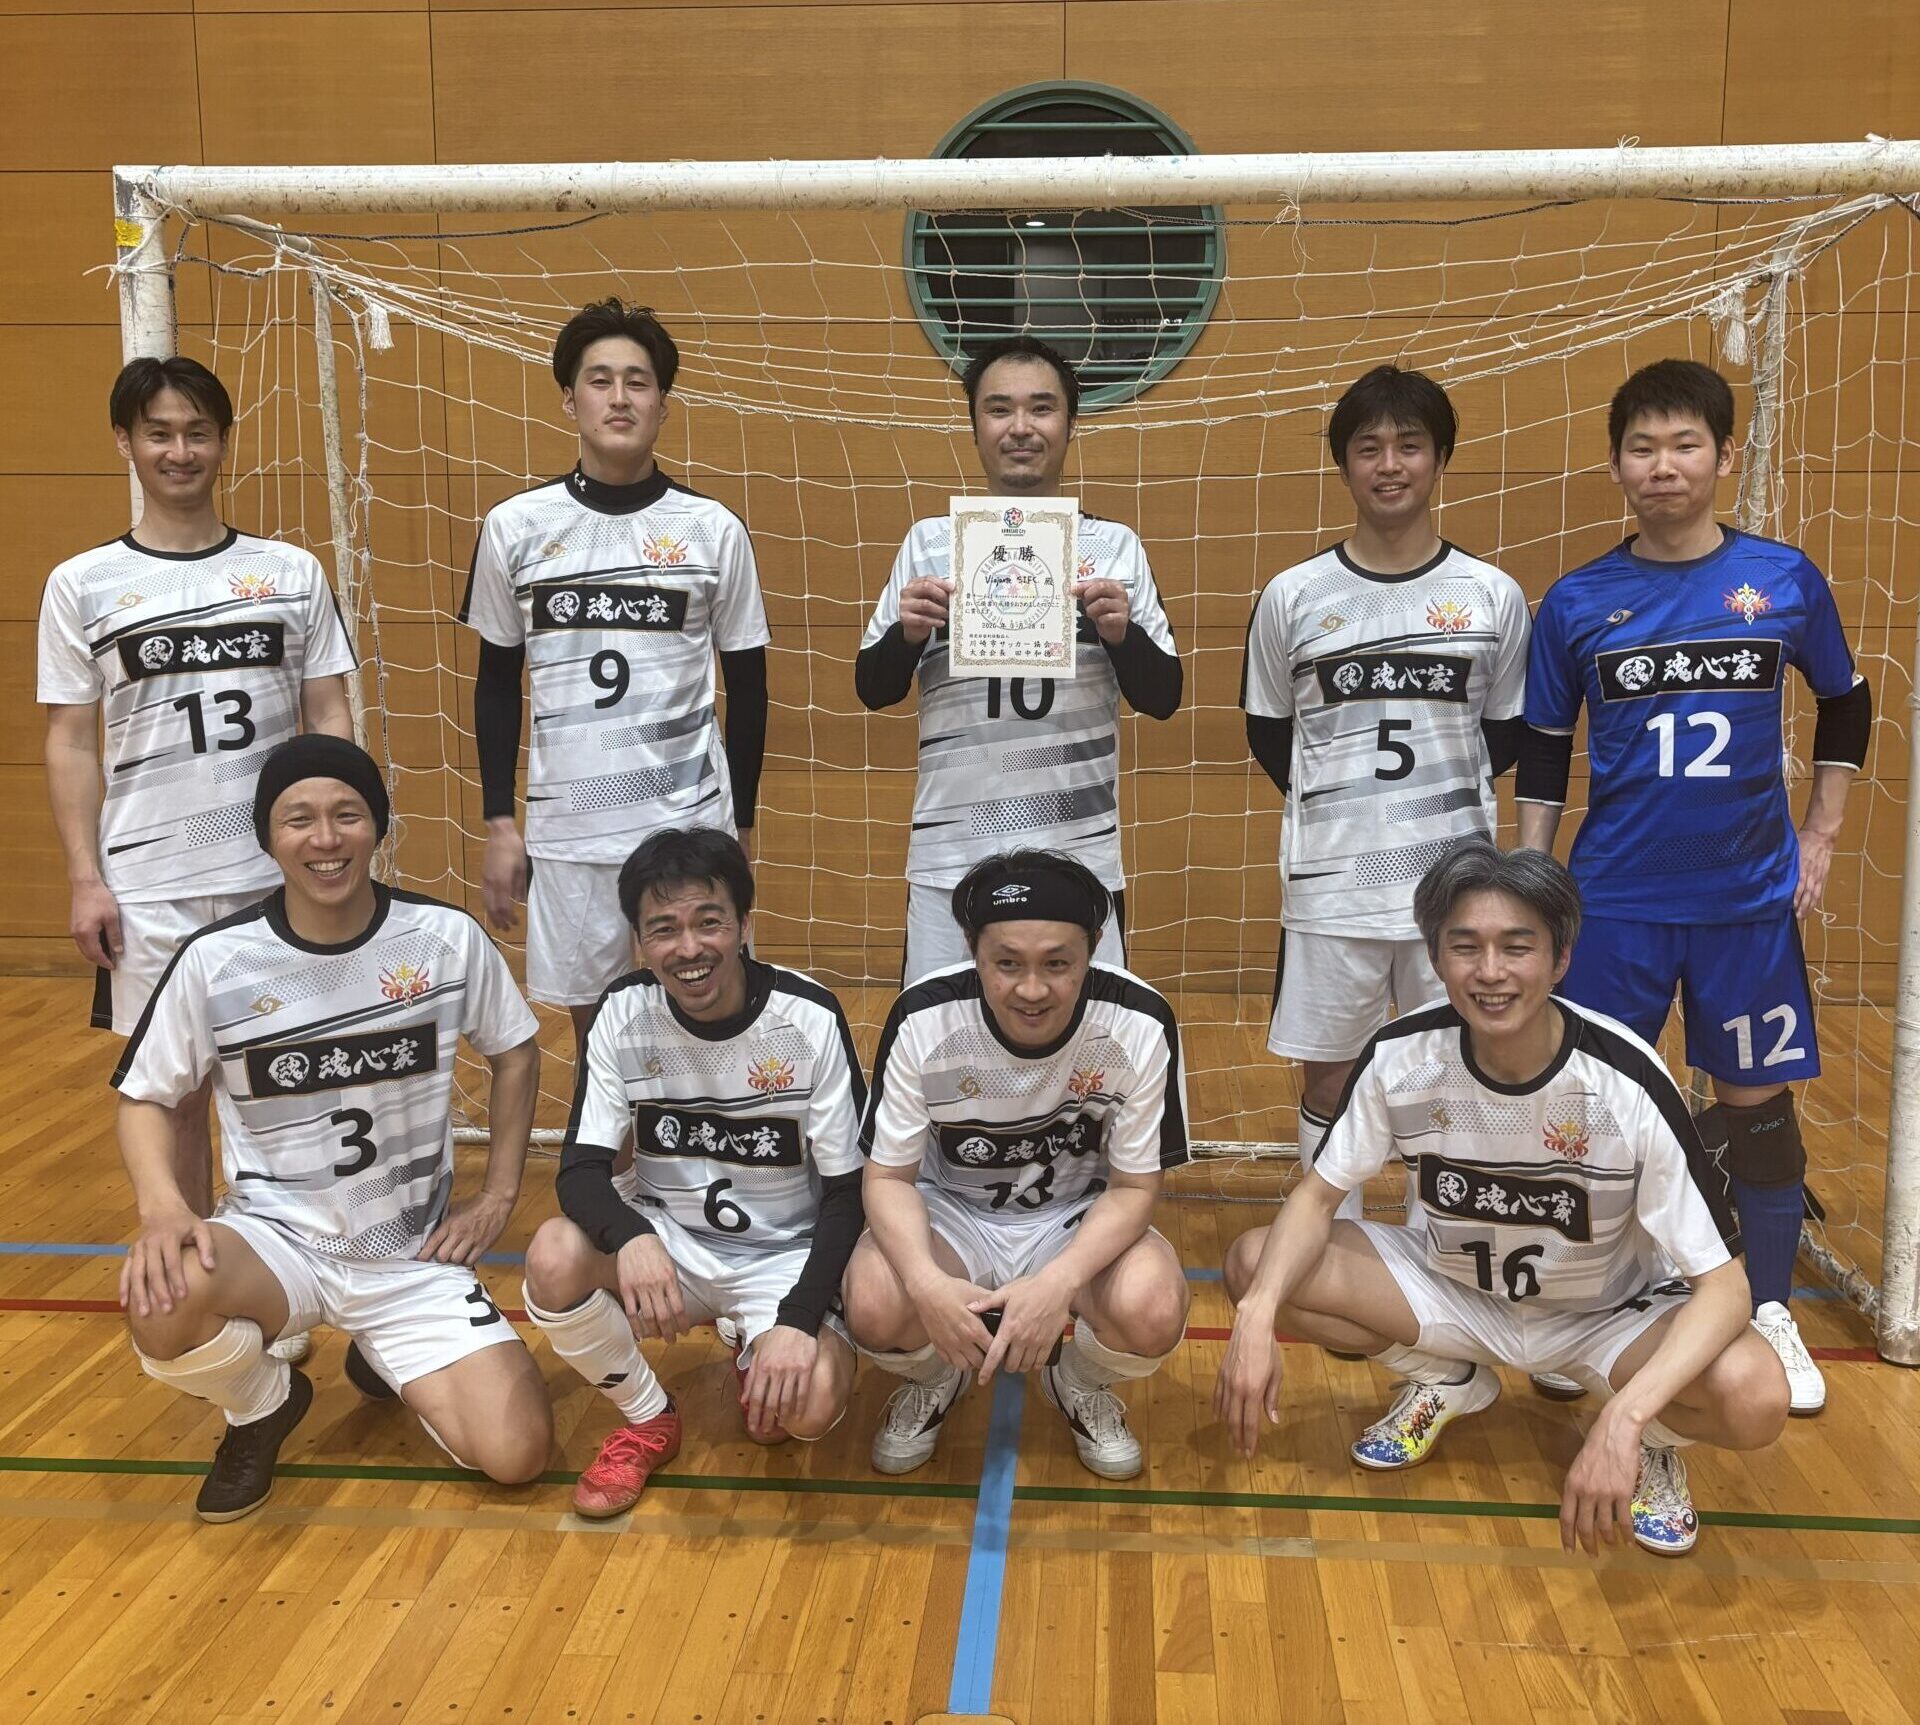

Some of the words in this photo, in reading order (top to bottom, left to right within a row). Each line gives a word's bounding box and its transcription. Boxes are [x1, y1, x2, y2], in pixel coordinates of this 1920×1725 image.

[992, 544, 1036, 562] 優勝
[586, 592, 670, 623] 魂心家
[181, 629, 272, 666] 魂心家
[1662, 648, 1763, 682] 魂心家
[590, 649, 630, 709] 9
[987, 676, 1055, 720] 10
[1370, 660, 1456, 693] 魂心家
[173, 689, 256, 754] 13
[1374, 719, 1416, 781] 5
[1646, 711, 1732, 777] 12
[993, 896, 1028, 906] umbro
[317, 1036, 420, 1080] 魂心家
[1722, 1003, 1806, 1070] 12
[330, 1108, 377, 1177] 3
[687, 1121, 782, 1158] 魂心家
[703, 1178, 752, 1234] 6
[1475, 1182, 1577, 1226] 魂心家
[1460, 1240, 1545, 1303] 16
